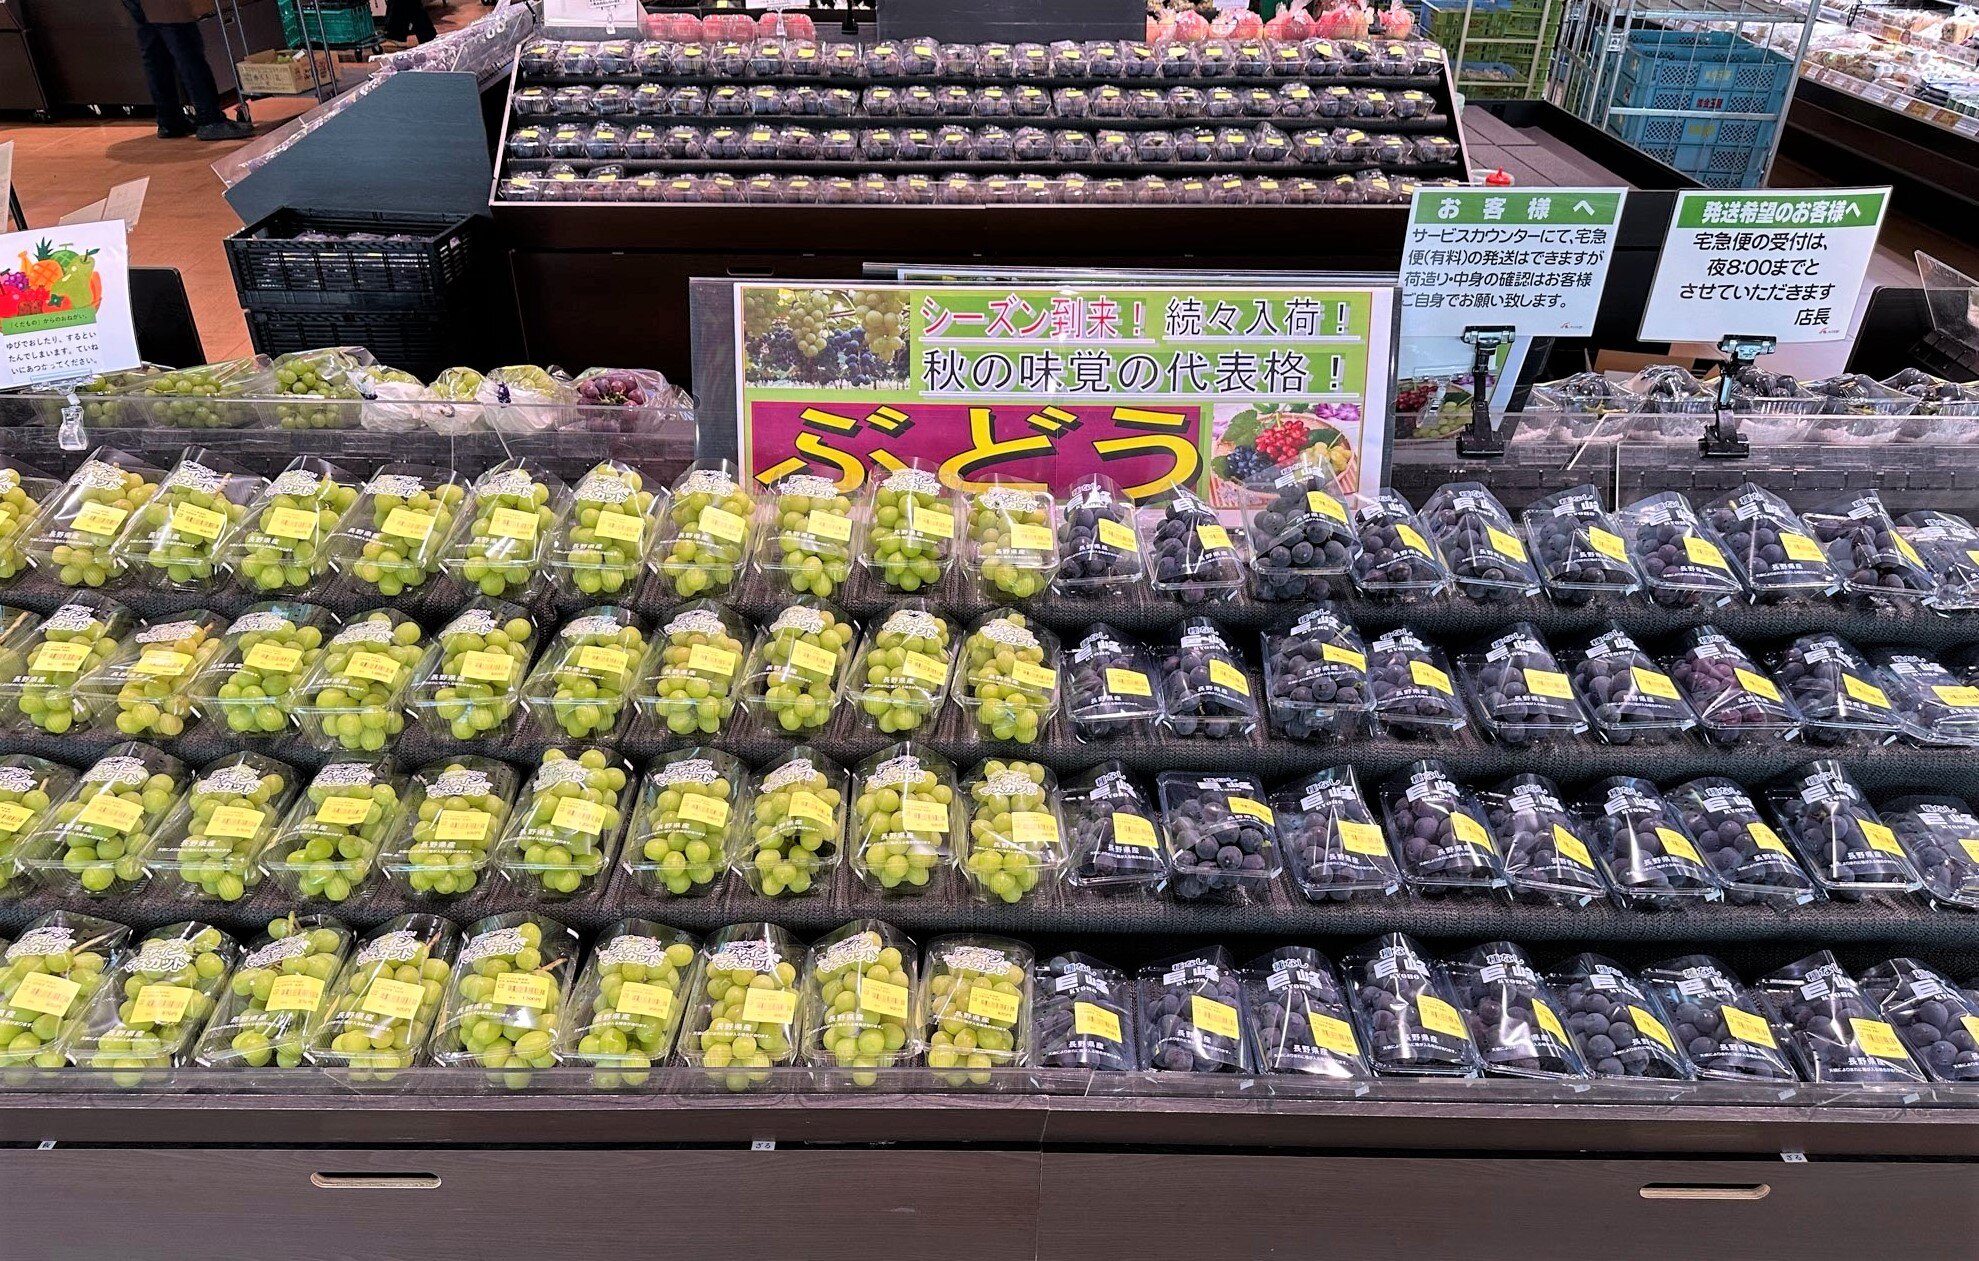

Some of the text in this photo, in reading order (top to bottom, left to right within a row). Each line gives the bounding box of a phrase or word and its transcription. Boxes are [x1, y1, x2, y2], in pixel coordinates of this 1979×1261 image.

[1701, 200, 1861, 224] 発送希望のお客様へ
[1412, 228, 1607, 244] サービスカウンターにて、宅急
[1693, 232, 1828, 251] 宅急便の受付は、
[1706, 258, 1819, 276] 夜8:00までと
[1402, 292, 1567, 308] ご自身でお願い致します。
[1679, 283, 1835, 300] させていただきます
[920, 296, 1348, 339] シーズン到来！ 続々入荷！
[1794, 307, 1832, 326] 店長
[922, 349, 1342, 394] 秋の味覚の代表格！
[754, 404, 1201, 500] ぶどう
